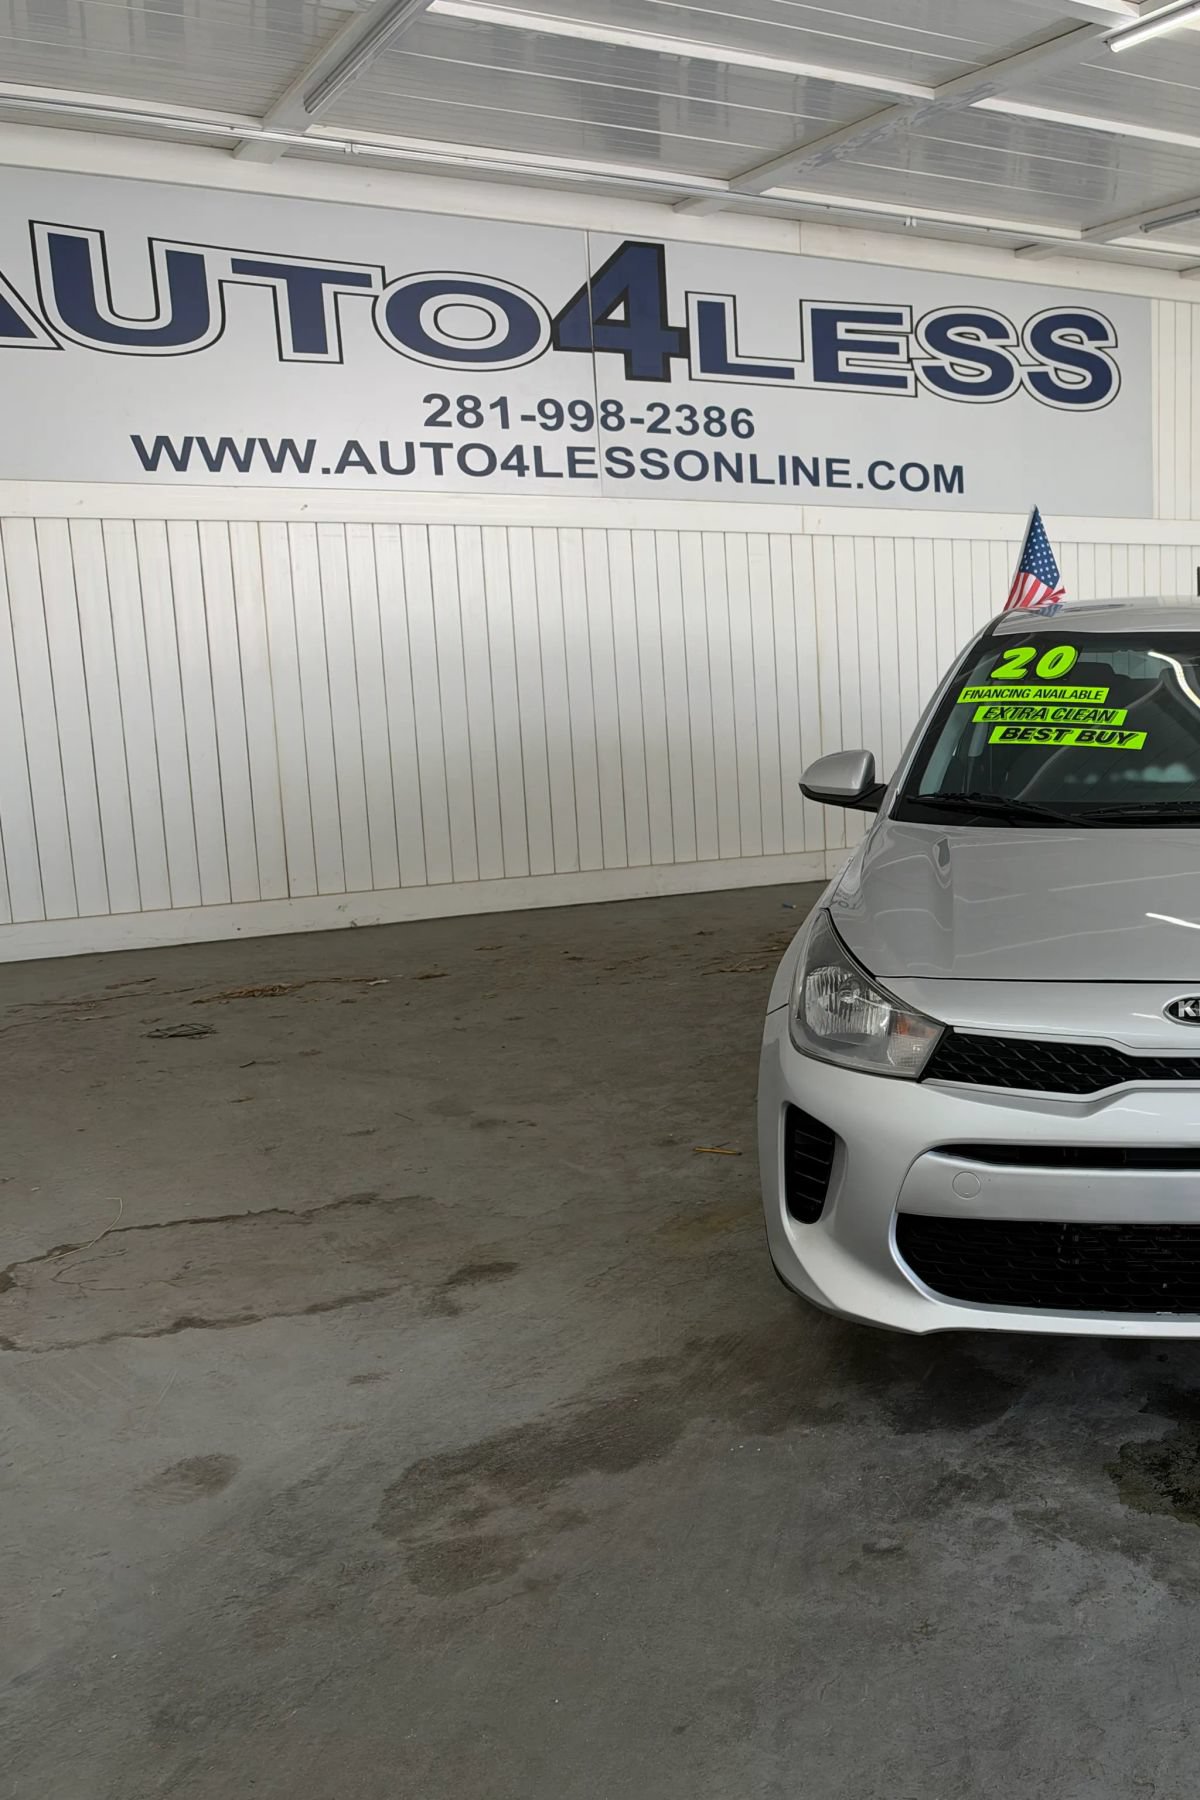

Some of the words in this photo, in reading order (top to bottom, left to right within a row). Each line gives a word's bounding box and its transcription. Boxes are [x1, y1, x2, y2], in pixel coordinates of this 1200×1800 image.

[0, 220, 1121, 411] UTO4LESS
[423, 393, 756, 439] 281-998-2386
[131, 434, 966, 495] WWW.AUTO4LESSONLINE.COM
[990, 645, 1079, 680] 20
[963, 688, 1031, 700] FINANCING
[1033, 689, 1104, 701] AVAILABLE
[983, 706, 1048, 722] EXTRA
[1050, 709, 1117, 724] CLEAN
[999, 727, 1074, 743] BEST
[1076, 729, 1137, 746] BUY
